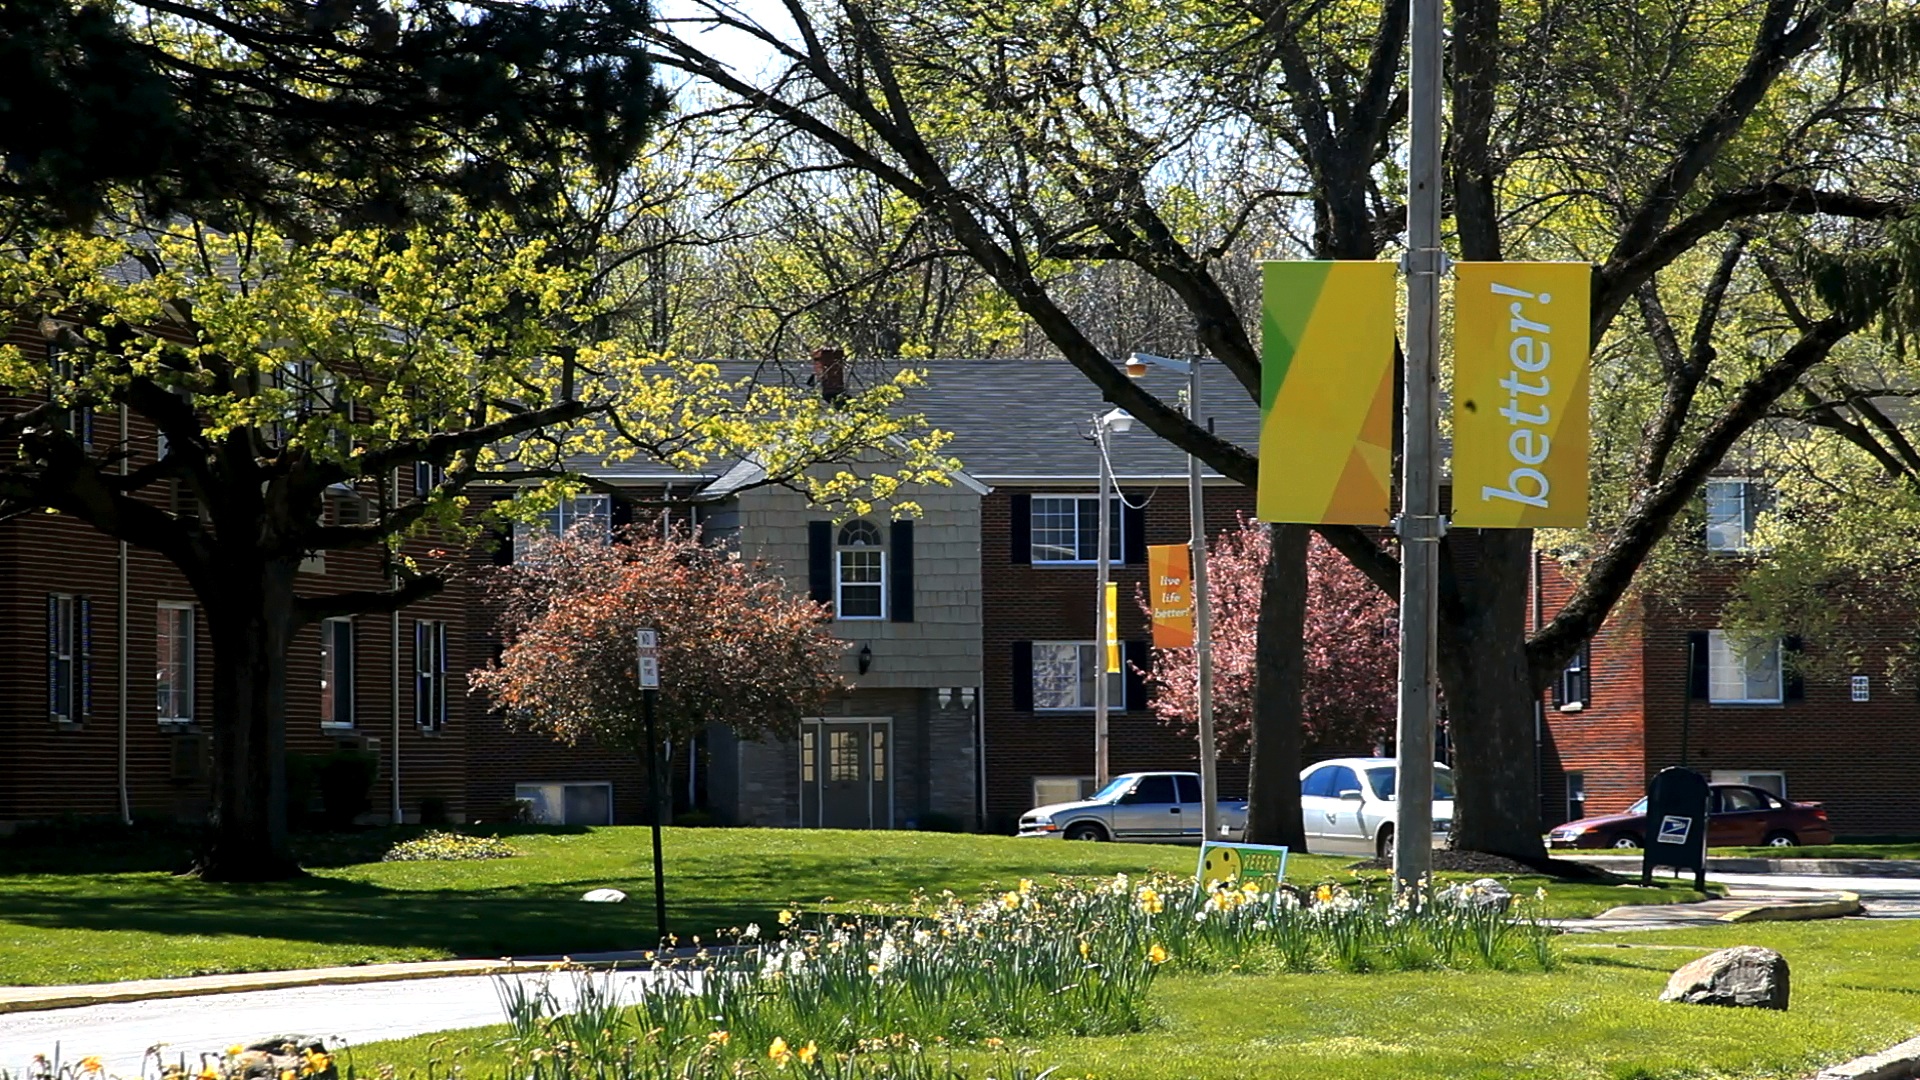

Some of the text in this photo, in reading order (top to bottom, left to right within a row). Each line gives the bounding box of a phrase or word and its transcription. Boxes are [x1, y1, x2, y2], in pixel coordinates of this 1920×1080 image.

[1482, 283, 1551, 508] better!
[1160, 575, 1181, 587] live
[1161, 592, 1181, 603] life
[1154, 607, 1190, 618] better!
[1243, 854, 1273, 871] REFER
